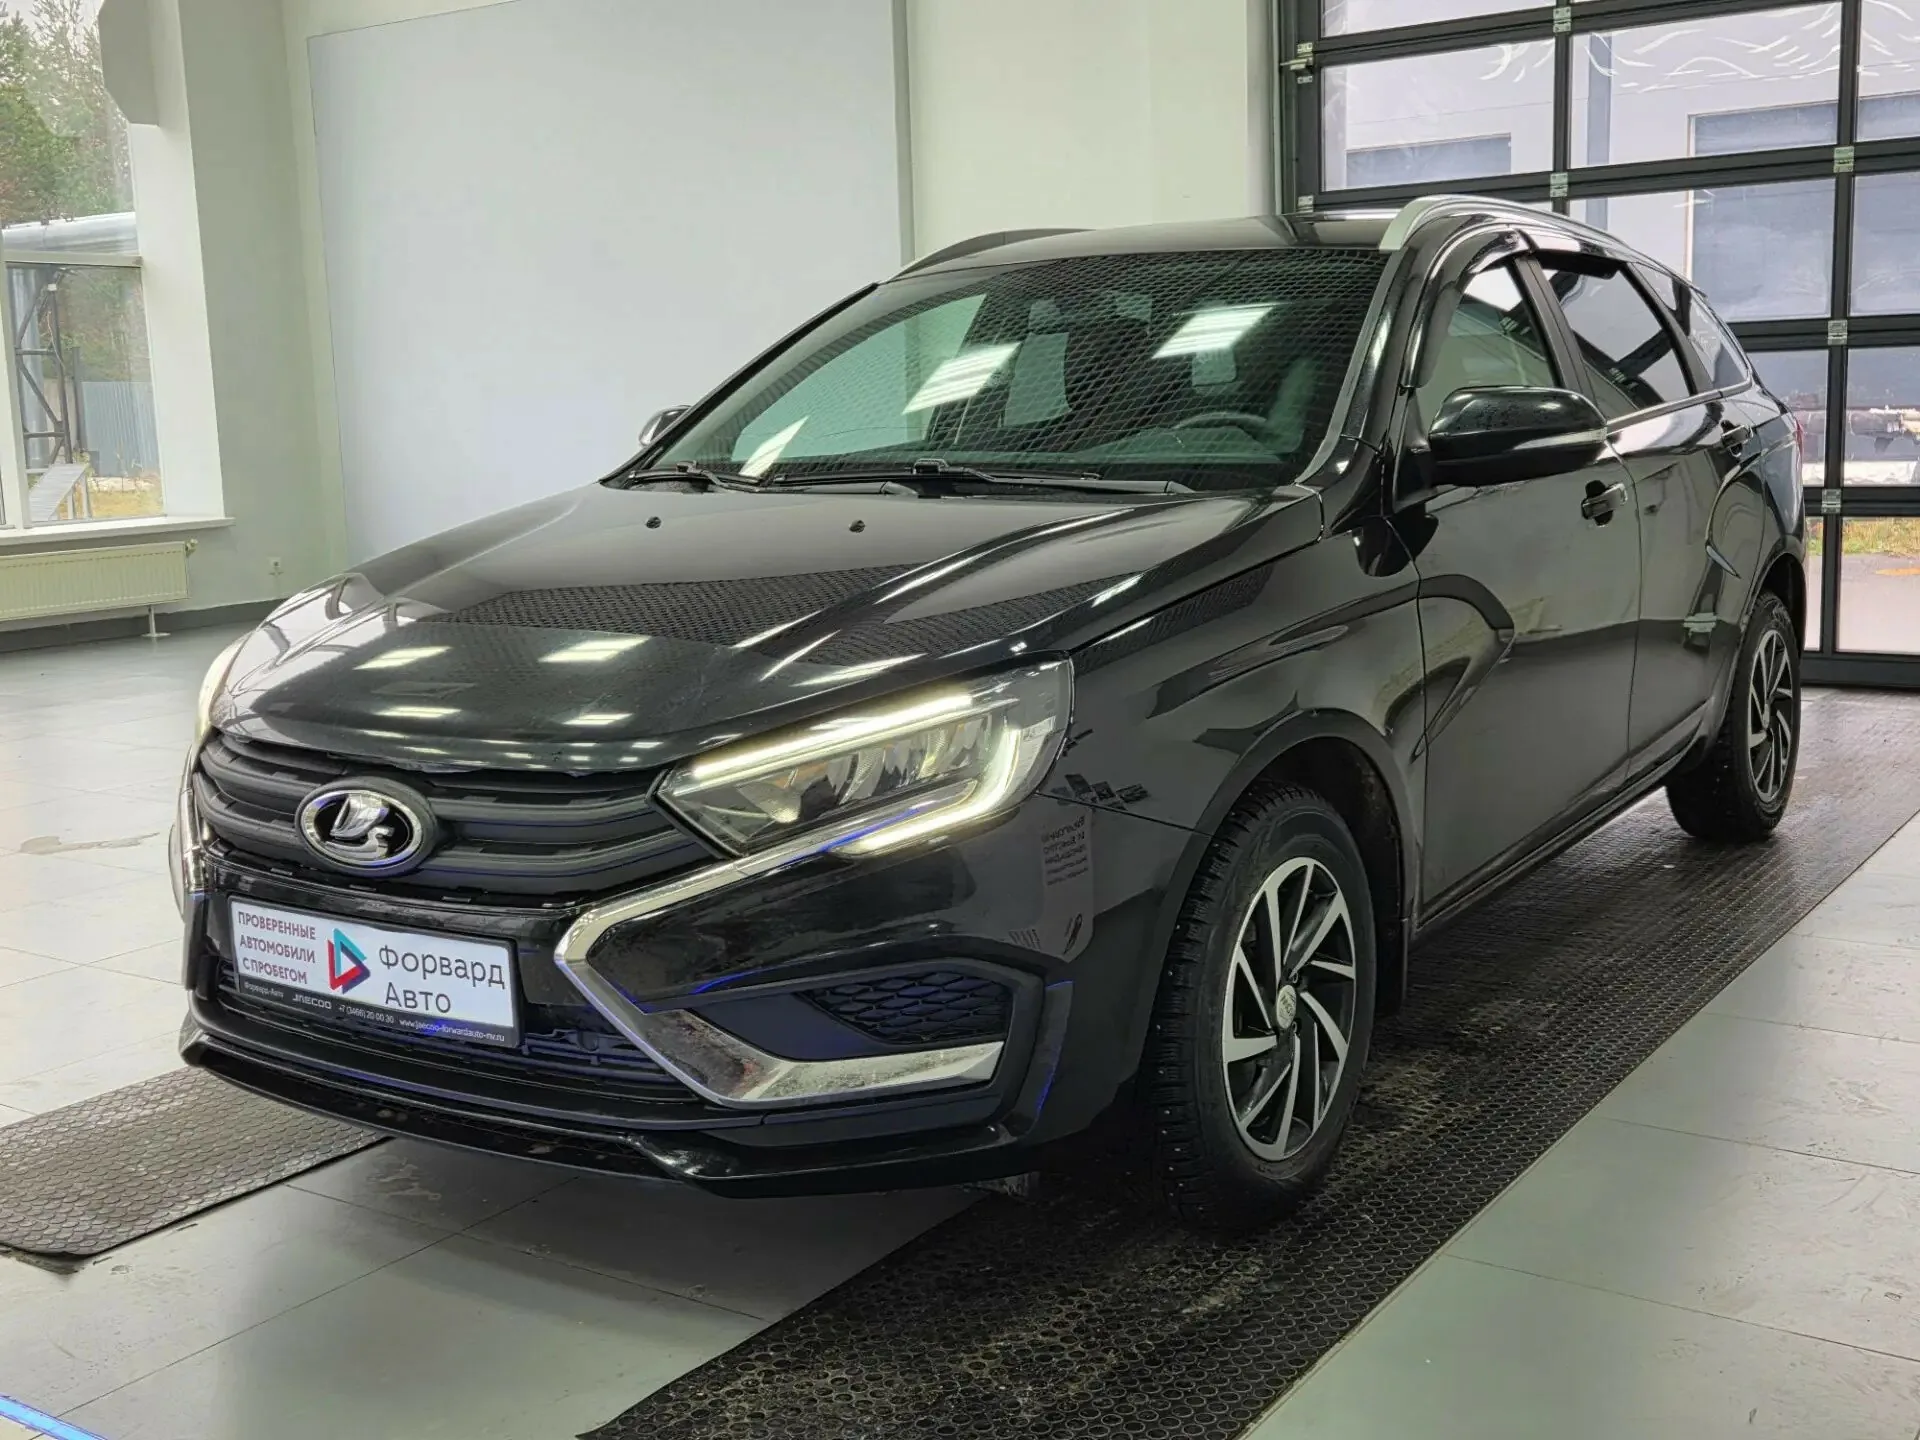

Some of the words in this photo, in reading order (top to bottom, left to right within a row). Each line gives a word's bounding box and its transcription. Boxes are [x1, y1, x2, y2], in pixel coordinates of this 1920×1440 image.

[238, 911, 316, 940] ПРОВЕРЕННЫЕ
[240, 934, 316, 963] АВТОМОБИЛИ
[242, 957, 250, 970] С
[250, 958, 308, 984] ПРОБЕГОМ
[378, 944, 506, 990] Форвард
[385, 981, 452, 1014] Авто
